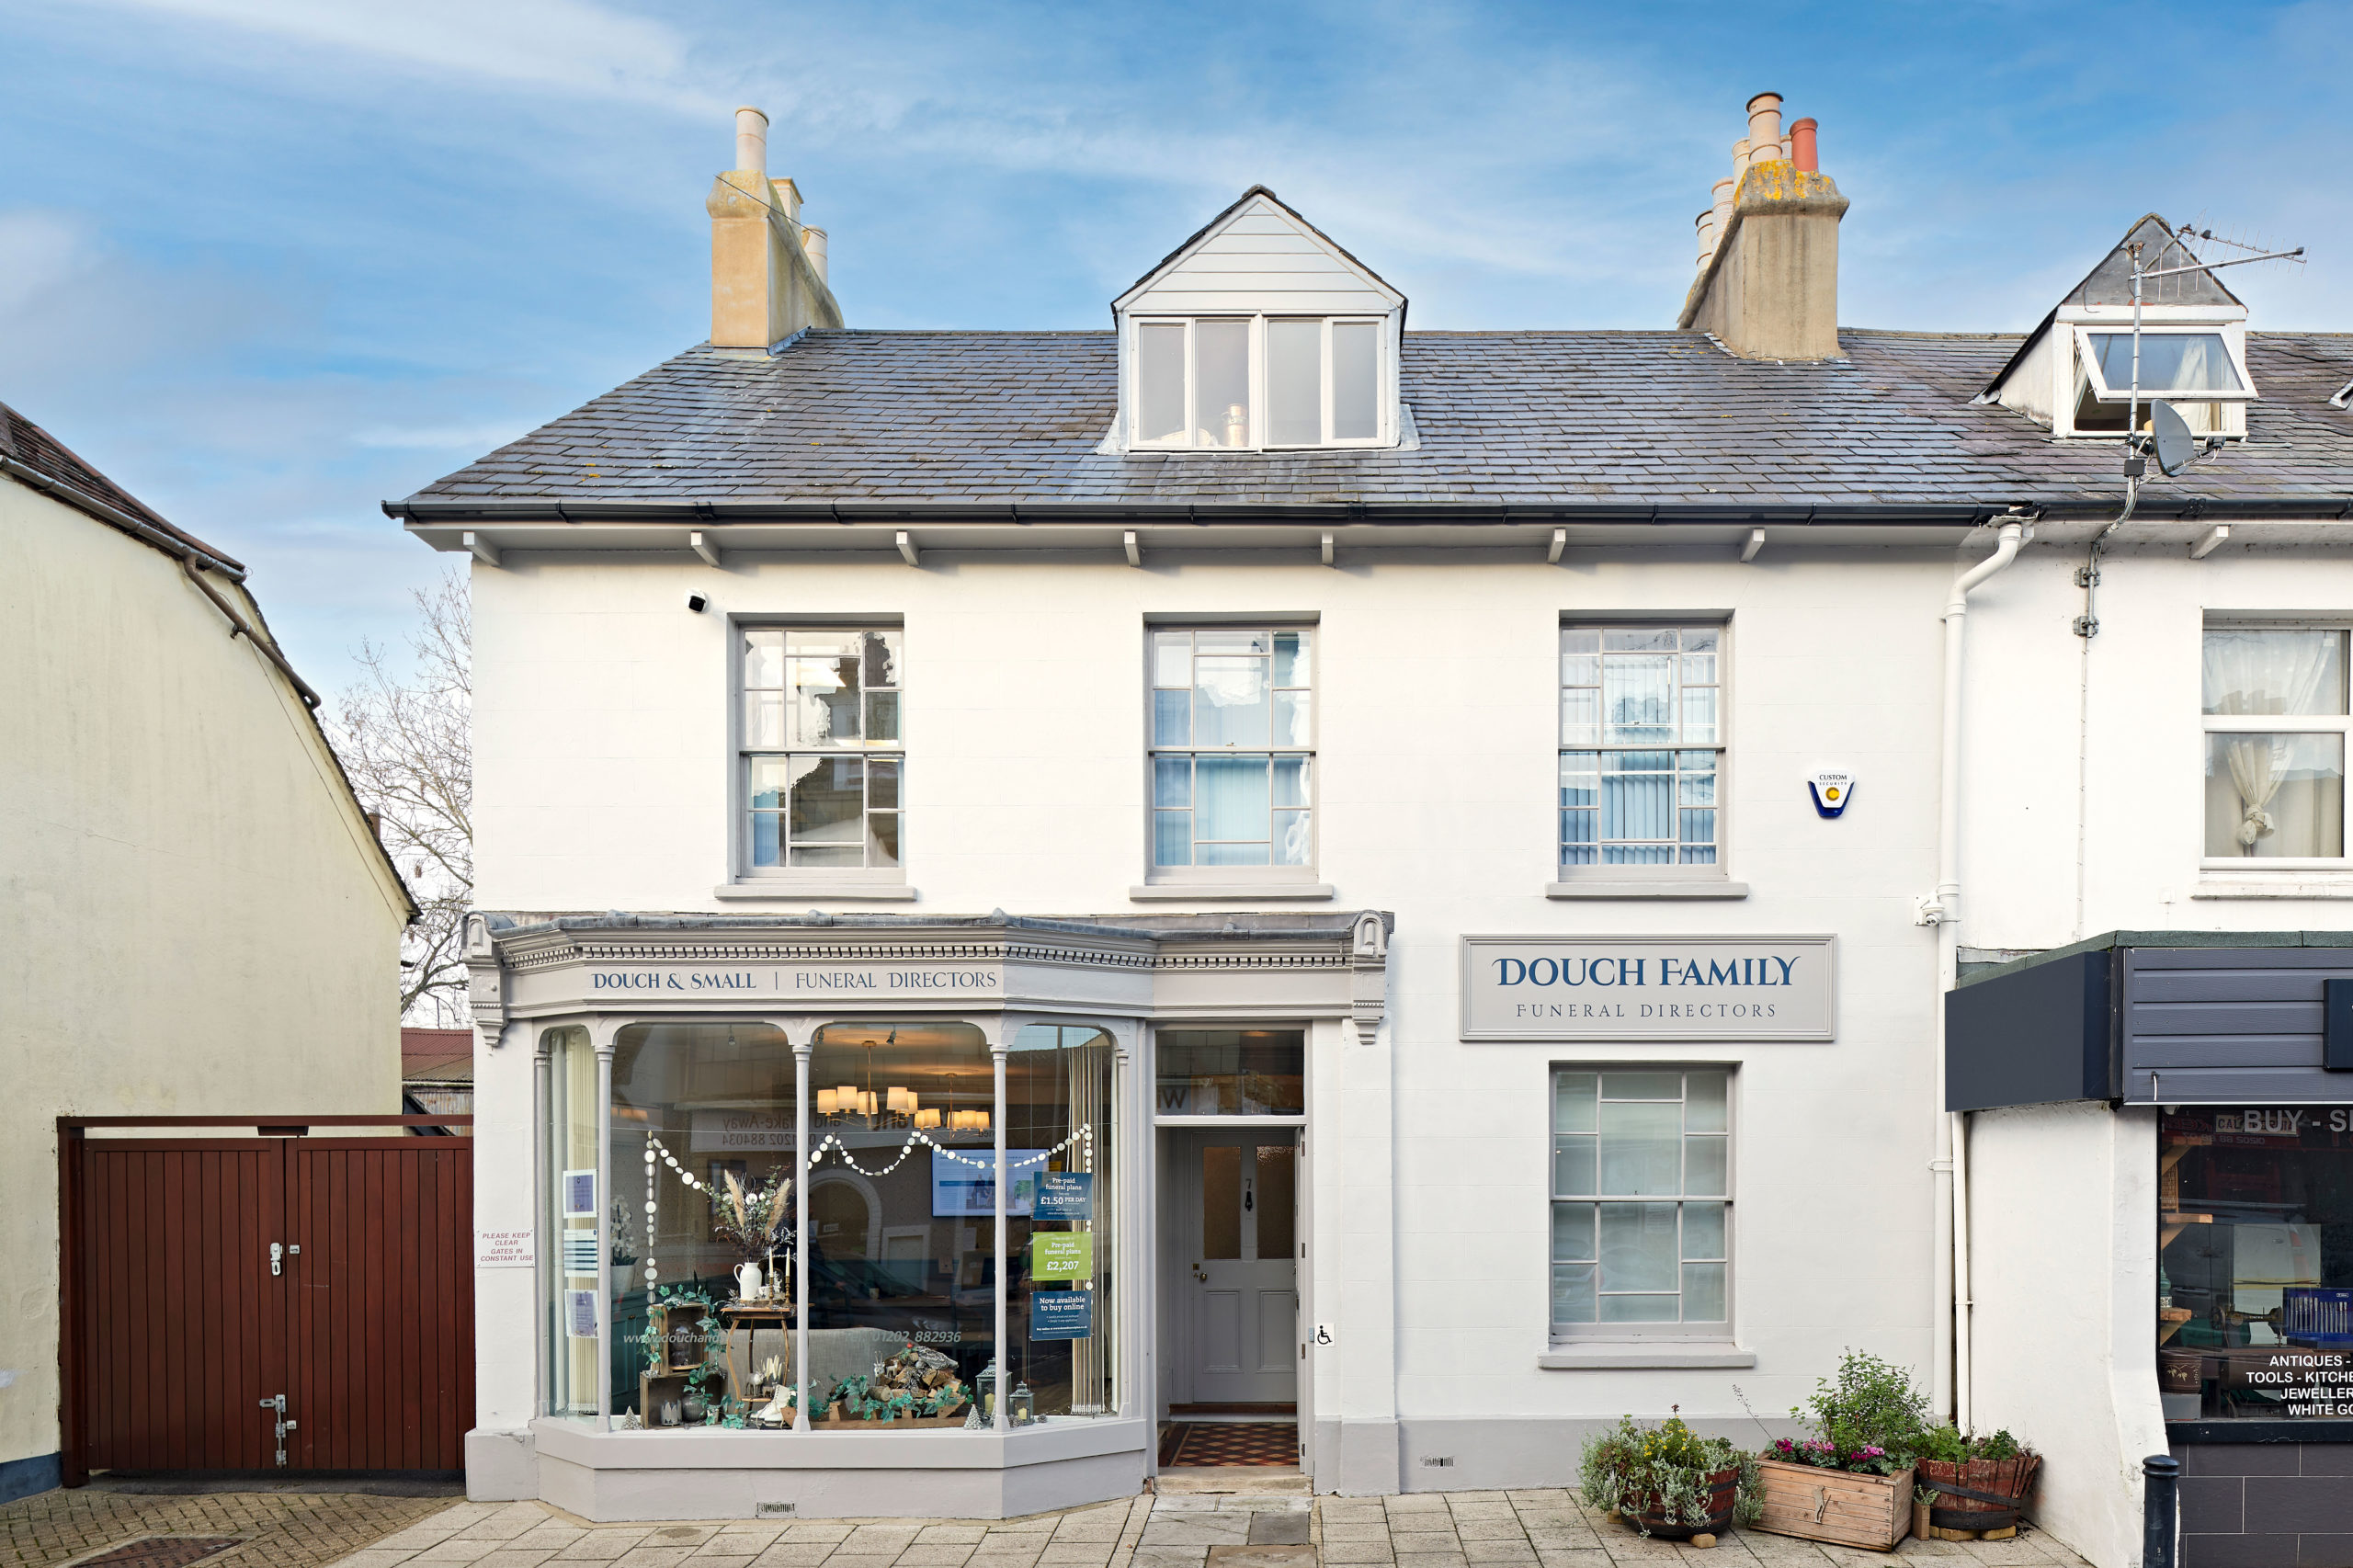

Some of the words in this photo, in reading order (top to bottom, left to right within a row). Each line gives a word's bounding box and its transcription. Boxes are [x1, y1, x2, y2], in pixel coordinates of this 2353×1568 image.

[1491, 957, 1647, 986] DOUCH
[1658, 955, 1802, 986] FAMILY
[591, 972, 660, 989] DOUCH
[666, 972, 685, 990] &
[690, 972, 756, 990] SMALL
[796, 972, 877, 989] FUNERAL
[887, 971, 996, 988] DIRECTORS
[1516, 1004, 1625, 1017] FUNERAL
[1640, 1004, 1776, 1017] DIRECTORS
[2244, 1109, 2303, 1132] BUY
[2329, 1109, 2353, 1132] S
[1051, 1177, 1075, 1186] Pre-paid
[1245, 1178, 1252, 1189] 7
[1040, 1197, 1063, 1205] £1.50
[1051, 1242, 1074, 1250] Pre-paid
[1066, 1248, 1082, 1256] plans
[1046, 1260, 1079, 1273] £2,207
[1049, 1304, 1062, 1312] buy
[871, 1330, 910, 1343] 01202
[915, 1330, 962, 1343] 882936
[2268, 1355, 2343, 1368] ANTIQUES
[2245, 1371, 2293, 1383] TOOLS
[2279, 1387, 2353, 1400] JEWELLER
[2288, 1403, 2334, 1415] WHITE
